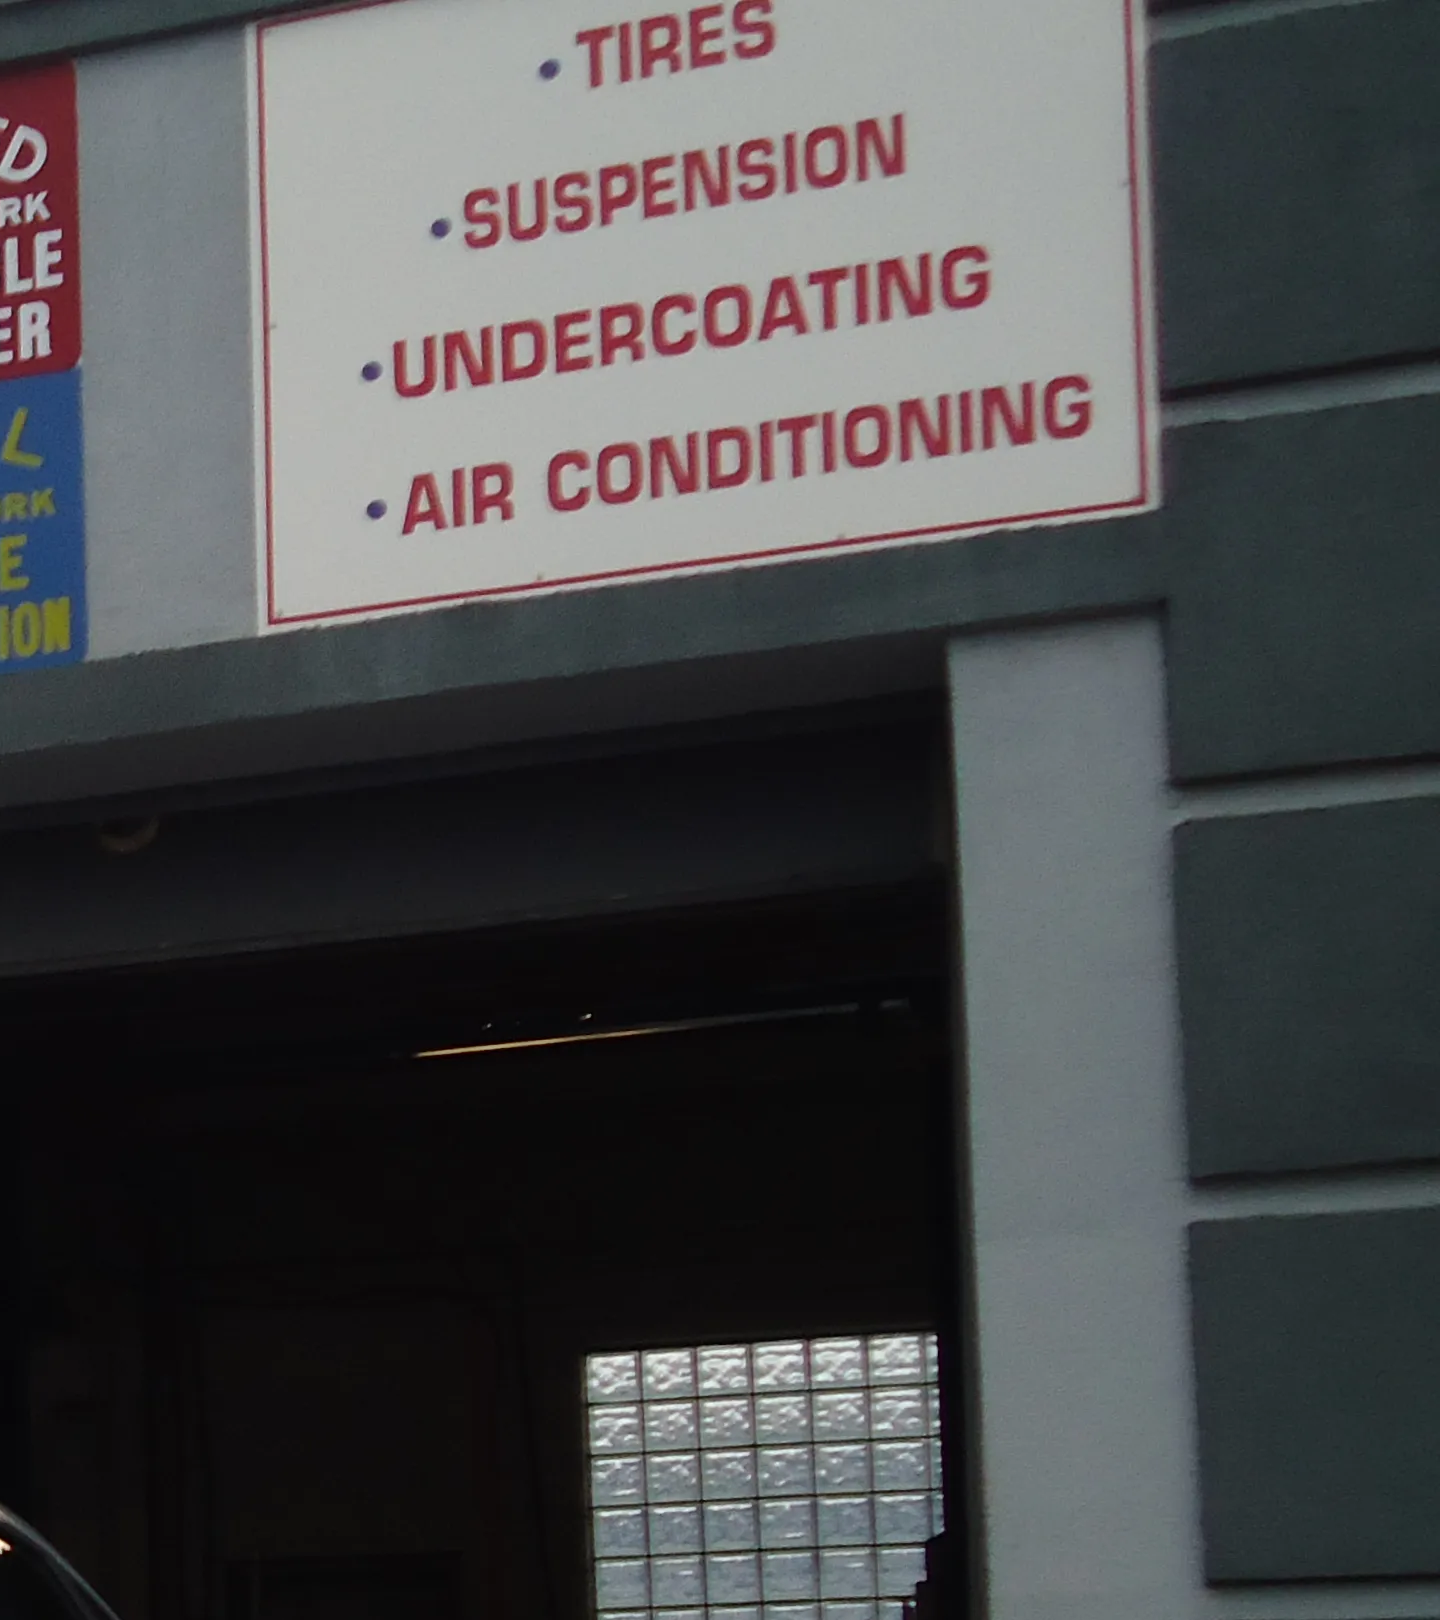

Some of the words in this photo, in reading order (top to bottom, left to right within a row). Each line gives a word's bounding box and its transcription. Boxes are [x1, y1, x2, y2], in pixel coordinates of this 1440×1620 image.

[574, 0, 778, 90] TIRES
[462, 112, 907, 250] SUSPENSION
[392, 244, 992, 399] UNDERCOATING
[400, 459, 516, 538] AIR
[546, 373, 1092, 513] CONDITIONING
